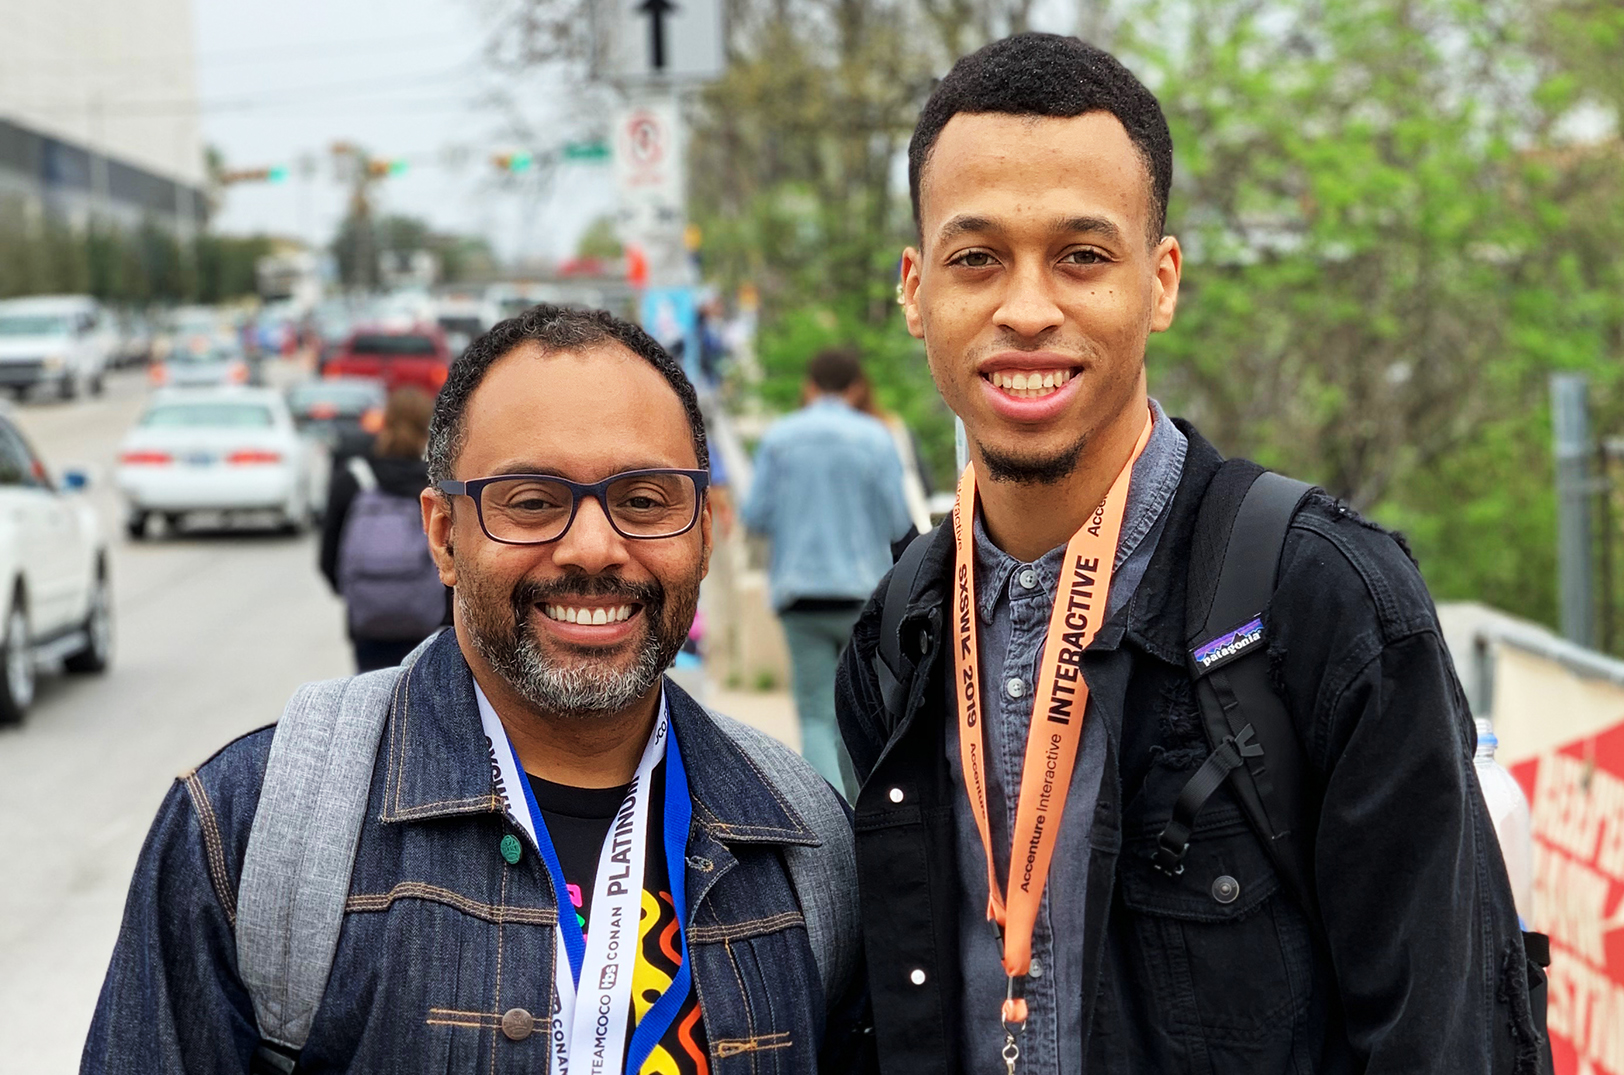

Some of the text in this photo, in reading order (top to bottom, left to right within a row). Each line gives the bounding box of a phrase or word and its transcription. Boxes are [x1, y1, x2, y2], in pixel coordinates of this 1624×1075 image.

[1047, 555, 1100, 725] INTERACTIVE
[1202, 632, 1261, 667] patagonia
[963, 665, 977, 728] 2019
[970, 743, 986, 820] Accenture
[1037, 733, 1062, 812] Interactive
[607, 775, 640, 897] PLATINUM
[1020, 815, 1046, 893] Accenture
[607, 906, 622, 961] CONAN
